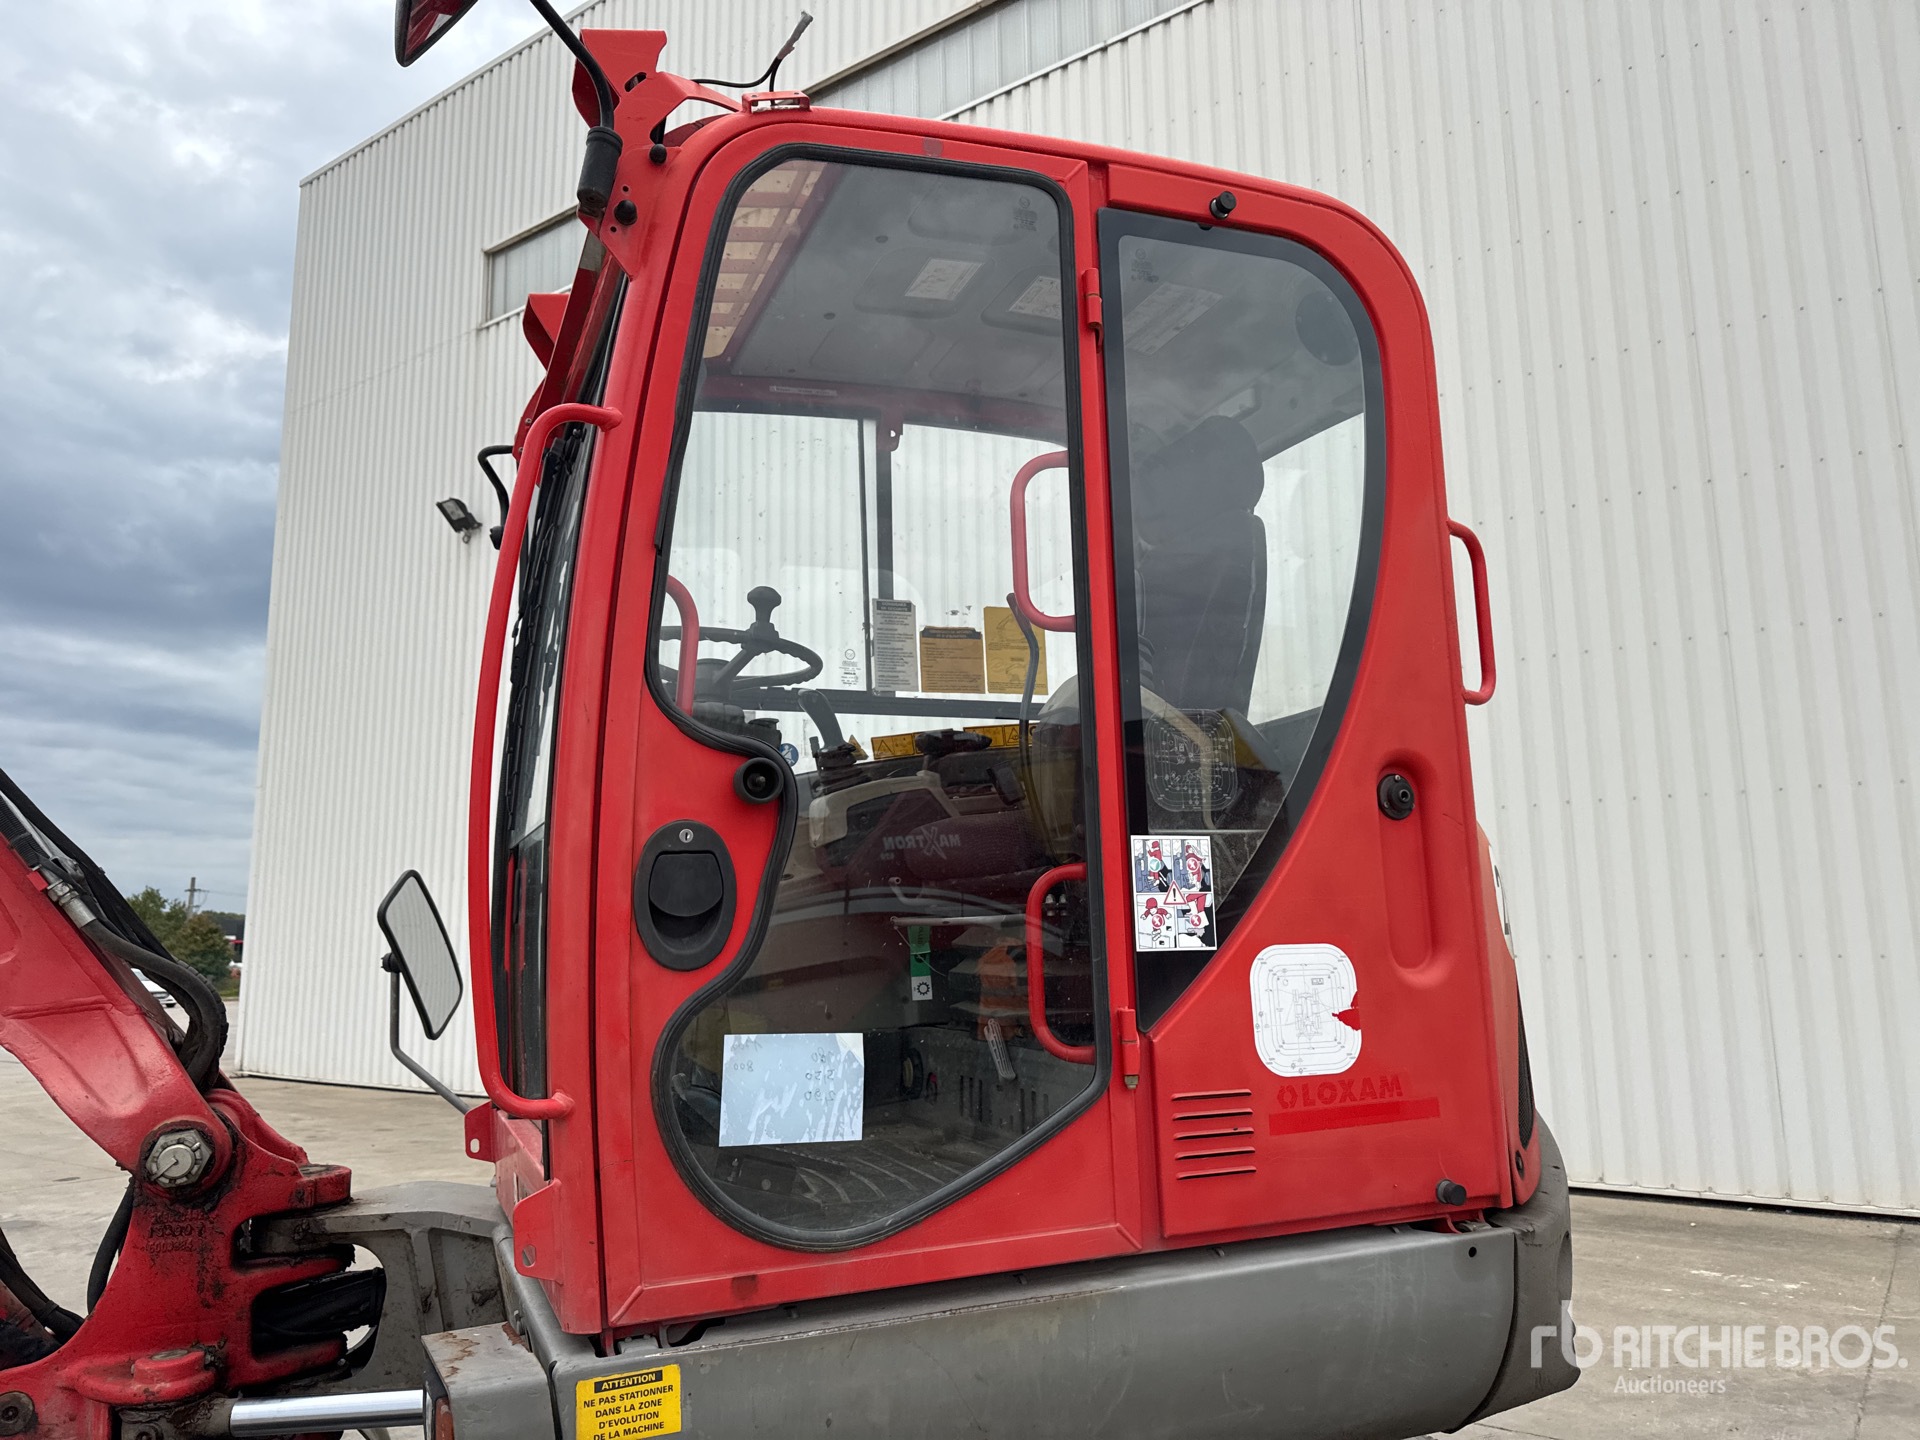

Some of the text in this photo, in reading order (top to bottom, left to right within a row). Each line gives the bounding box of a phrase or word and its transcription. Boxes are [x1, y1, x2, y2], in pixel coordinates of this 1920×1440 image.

[602, 1374, 656, 1390] ATTENTION
[583, 1386, 673, 1409] NE PAS STATIONNER
[595, 1399, 663, 1418] DANS LA ZONE
[599, 1412, 659, 1429] D'EVOLUTION
[608, 1430, 620, 1439] LA
[623, 1422, 664, 1437] MACHINE
